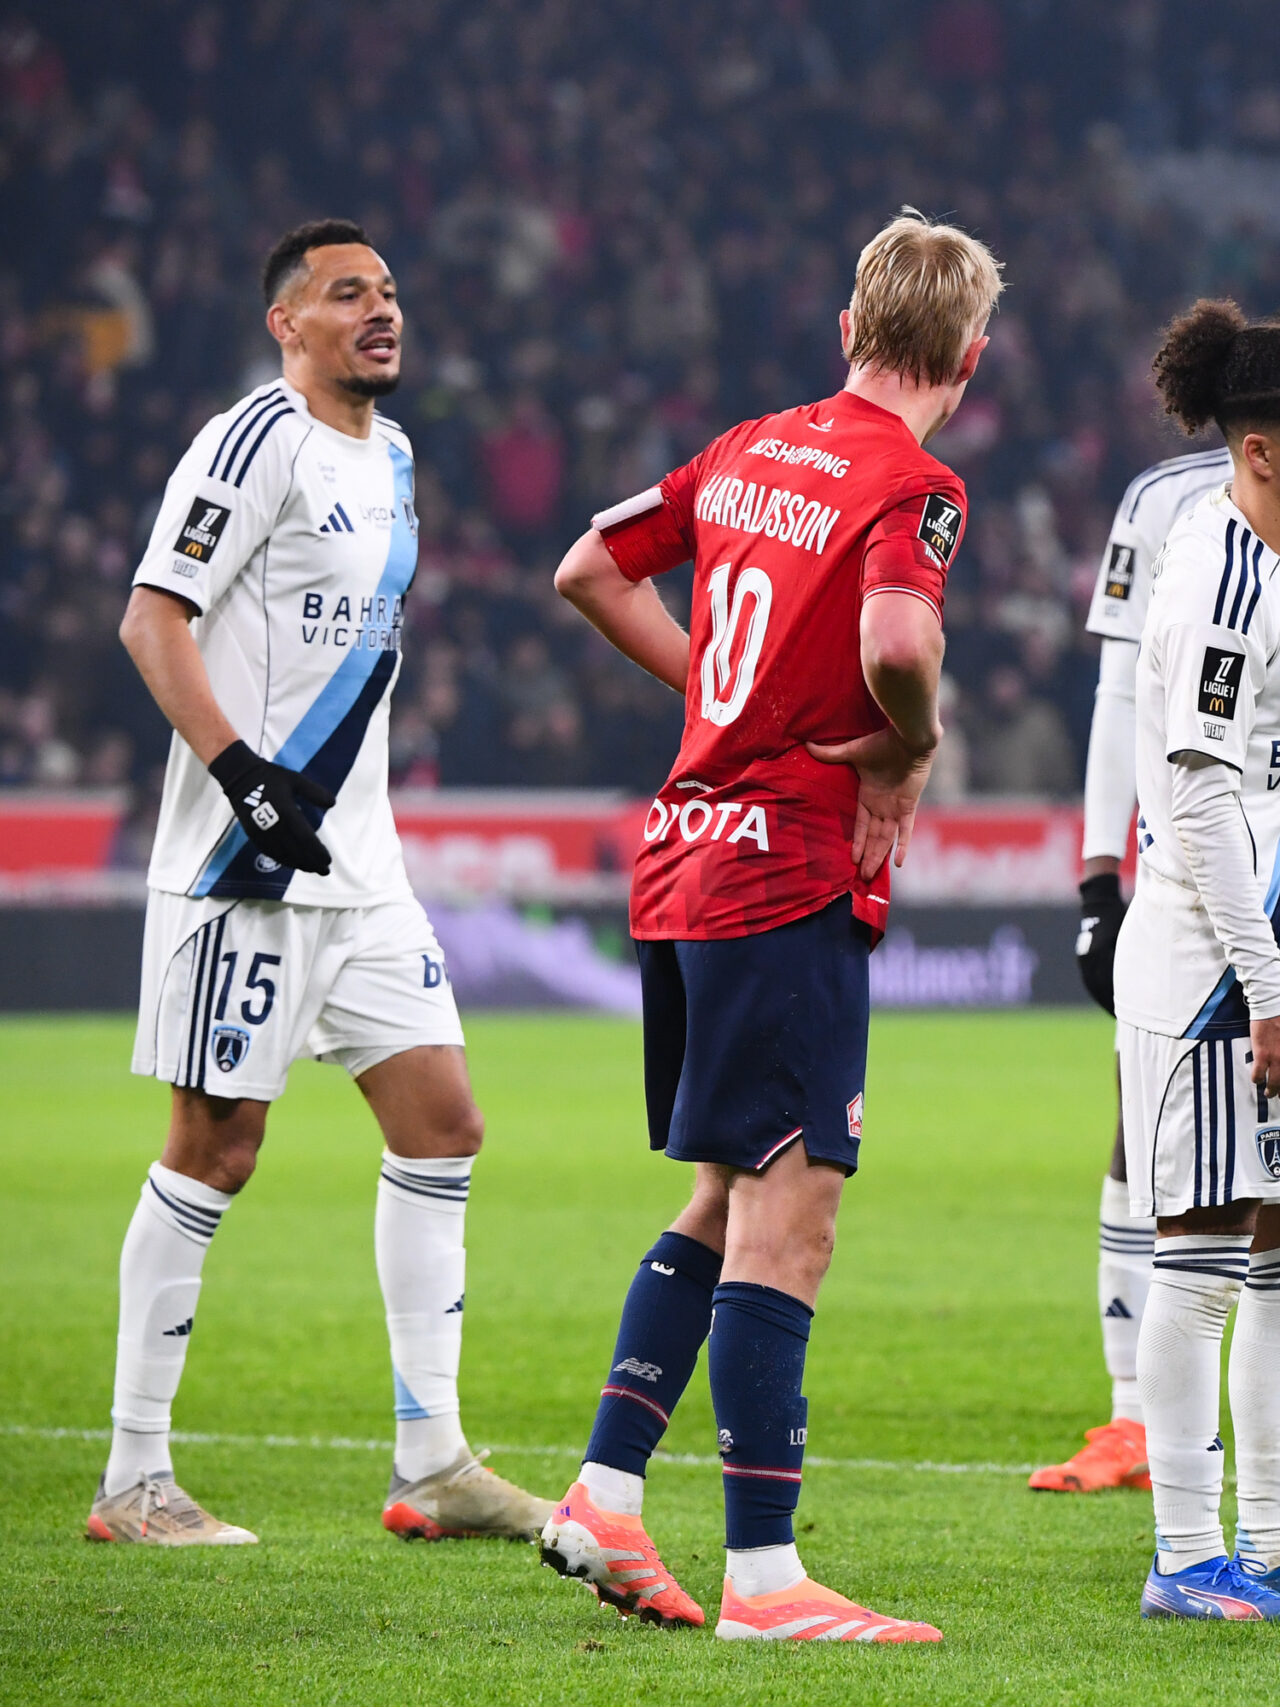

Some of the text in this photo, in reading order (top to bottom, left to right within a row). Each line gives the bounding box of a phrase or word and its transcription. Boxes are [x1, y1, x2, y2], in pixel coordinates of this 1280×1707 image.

[696, 474, 841, 555] HARALDSSON
[926, 517, 955, 546] LIGUE 1
[701, 561, 773, 727] 10
[1203, 680, 1235, 699] LIGUE 1
[256, 807, 275, 827] 15
[214, 951, 281, 1025] 15
[1260, 1131, 1280, 1140] PARIS
